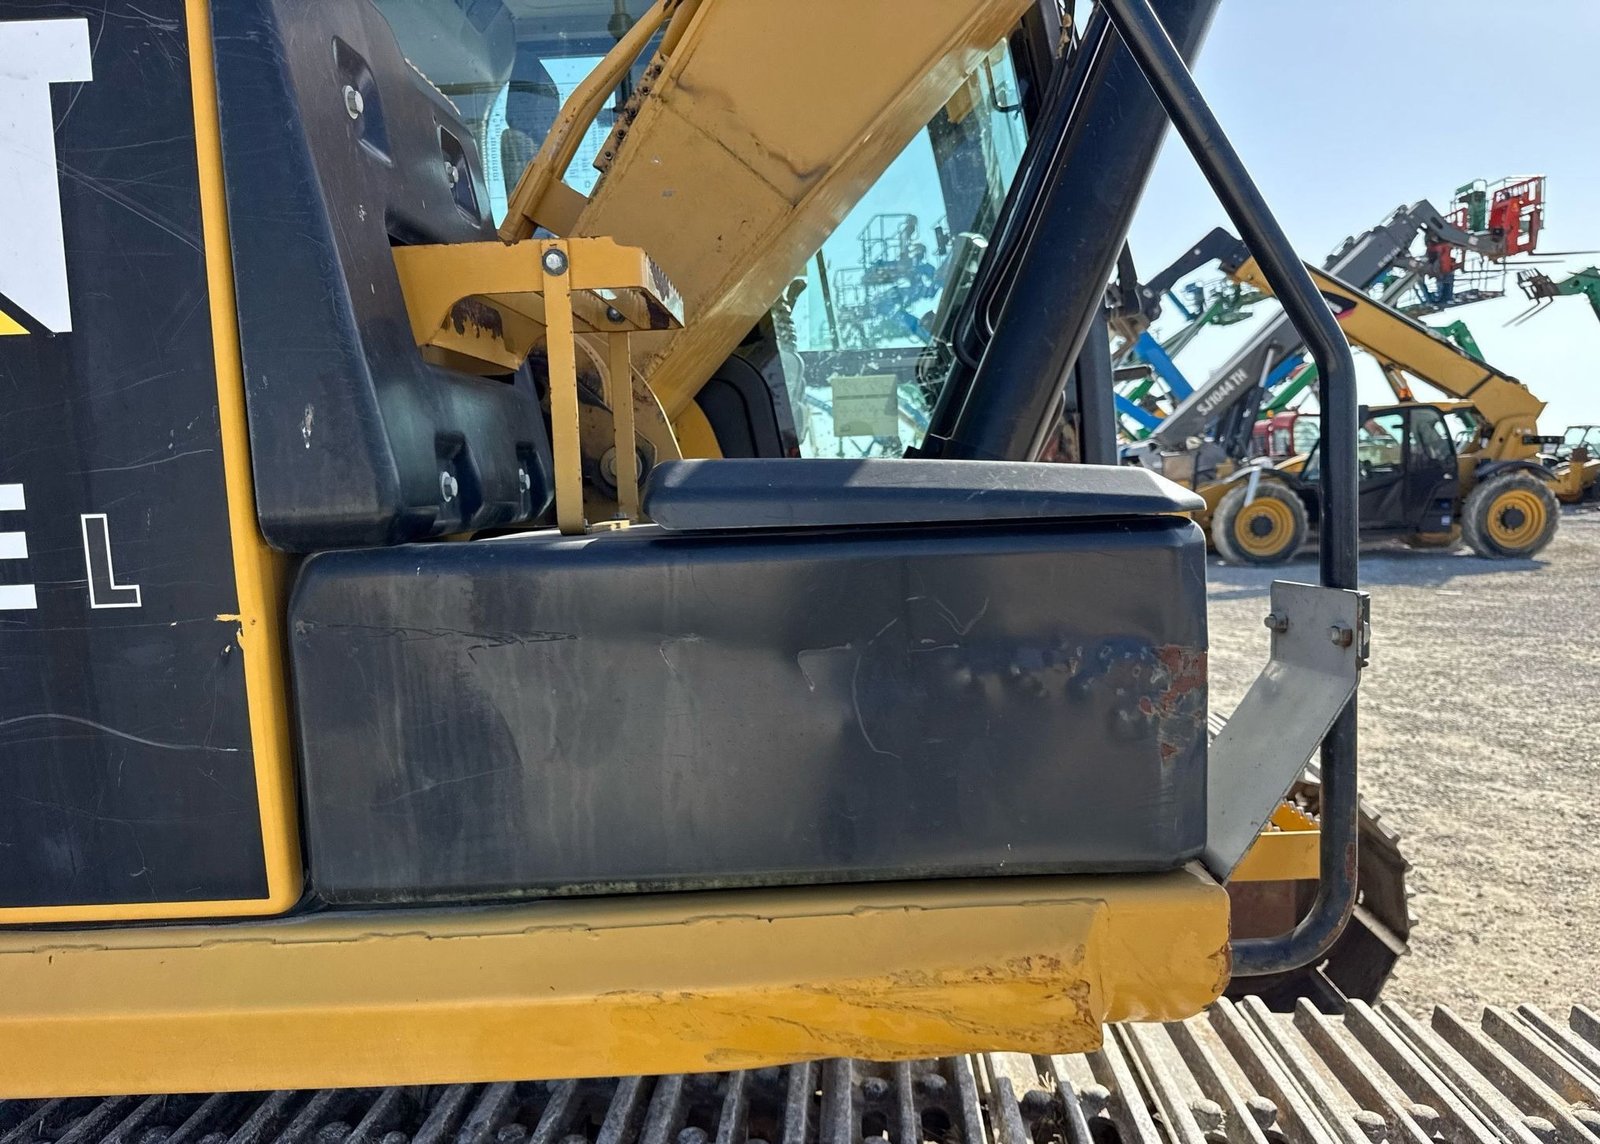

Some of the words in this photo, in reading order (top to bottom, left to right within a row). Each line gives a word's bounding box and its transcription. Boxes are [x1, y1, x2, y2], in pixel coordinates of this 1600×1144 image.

[1197, 382, 1234, 416] SJ1044
[1230, 369, 1248, 386] TH
[81, 513, 142, 609] L
